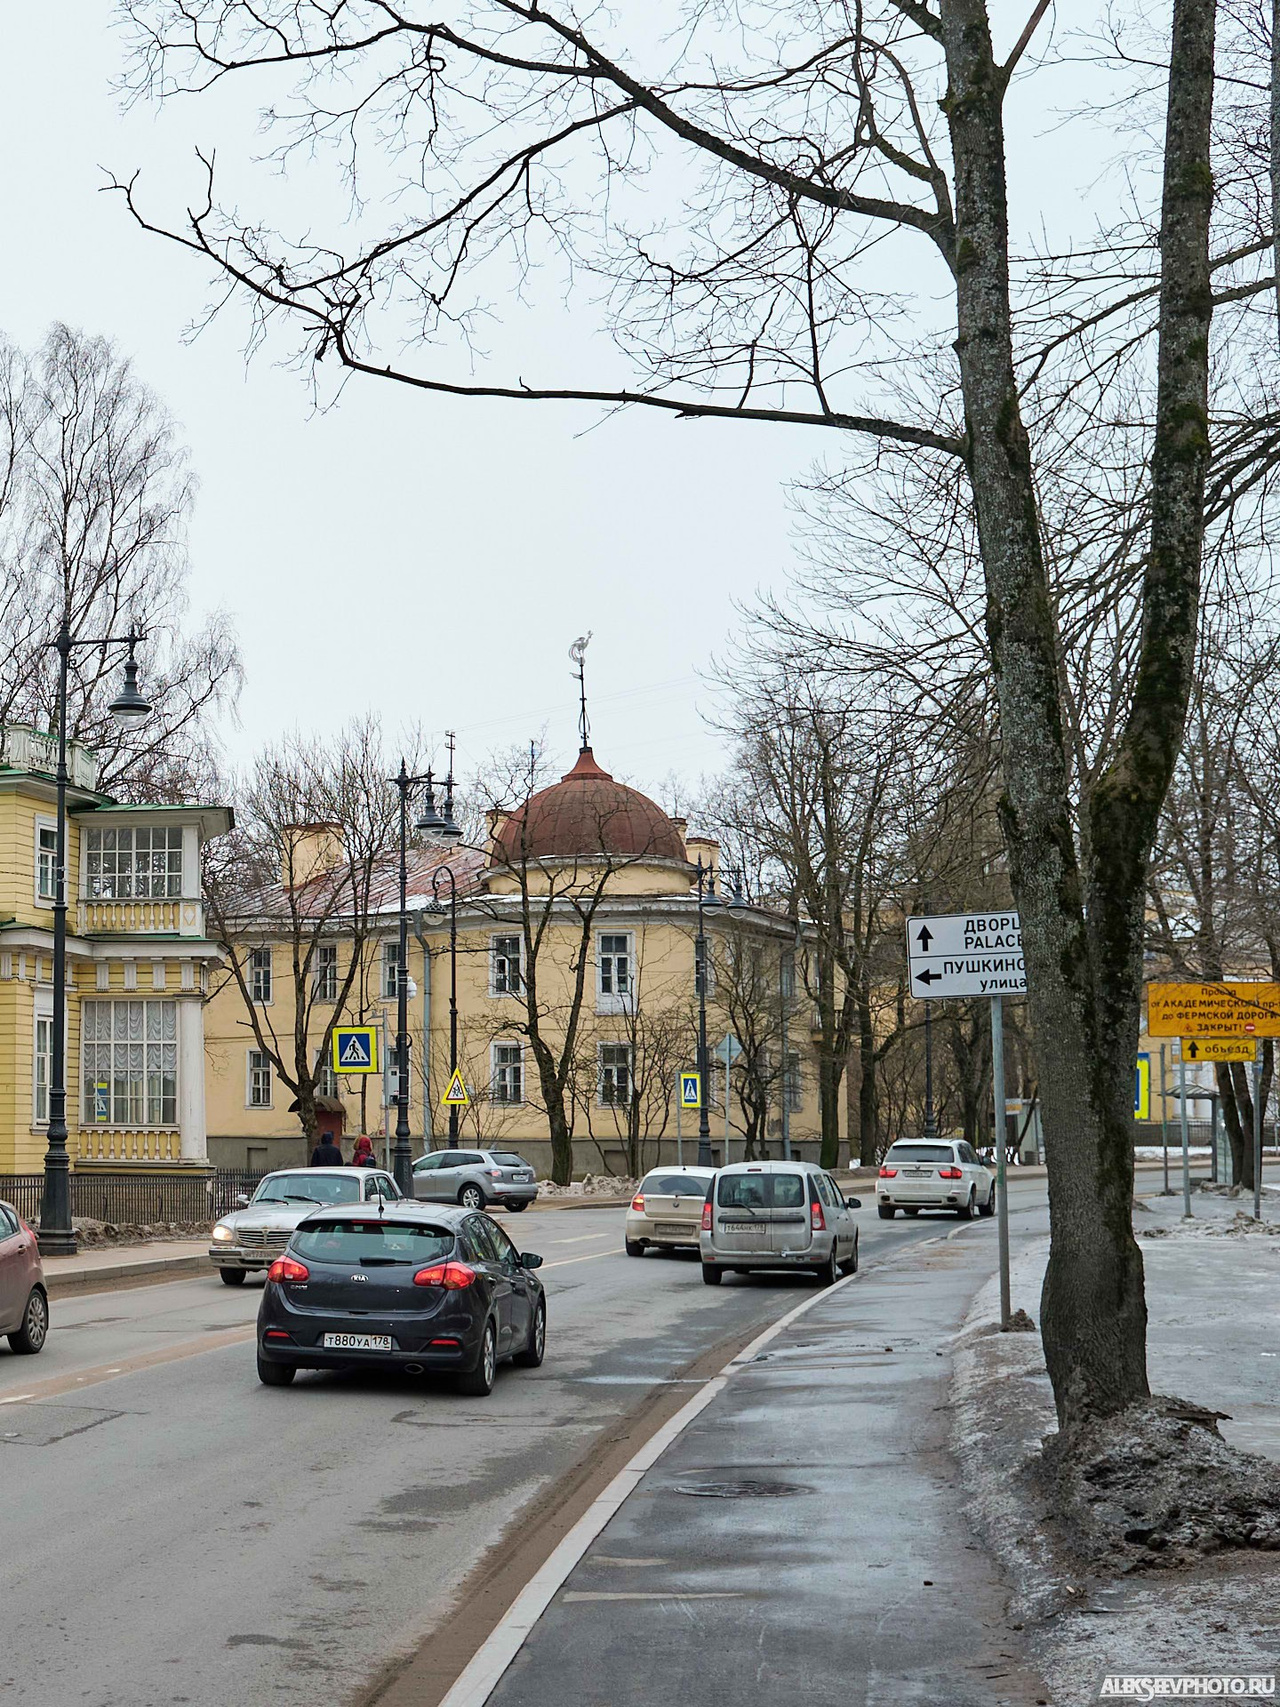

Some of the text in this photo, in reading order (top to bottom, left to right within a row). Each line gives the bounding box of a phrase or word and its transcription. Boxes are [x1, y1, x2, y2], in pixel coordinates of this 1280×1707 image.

[980, 978, 1027, 992] улица
[1176, 1010, 1234, 1020] ФЕРМСКОЙ
[1205, 1044, 1249, 1054] объезд
[353, 1274, 366, 1282] KIA
[328, 1335, 370, 1347] Т880УА
